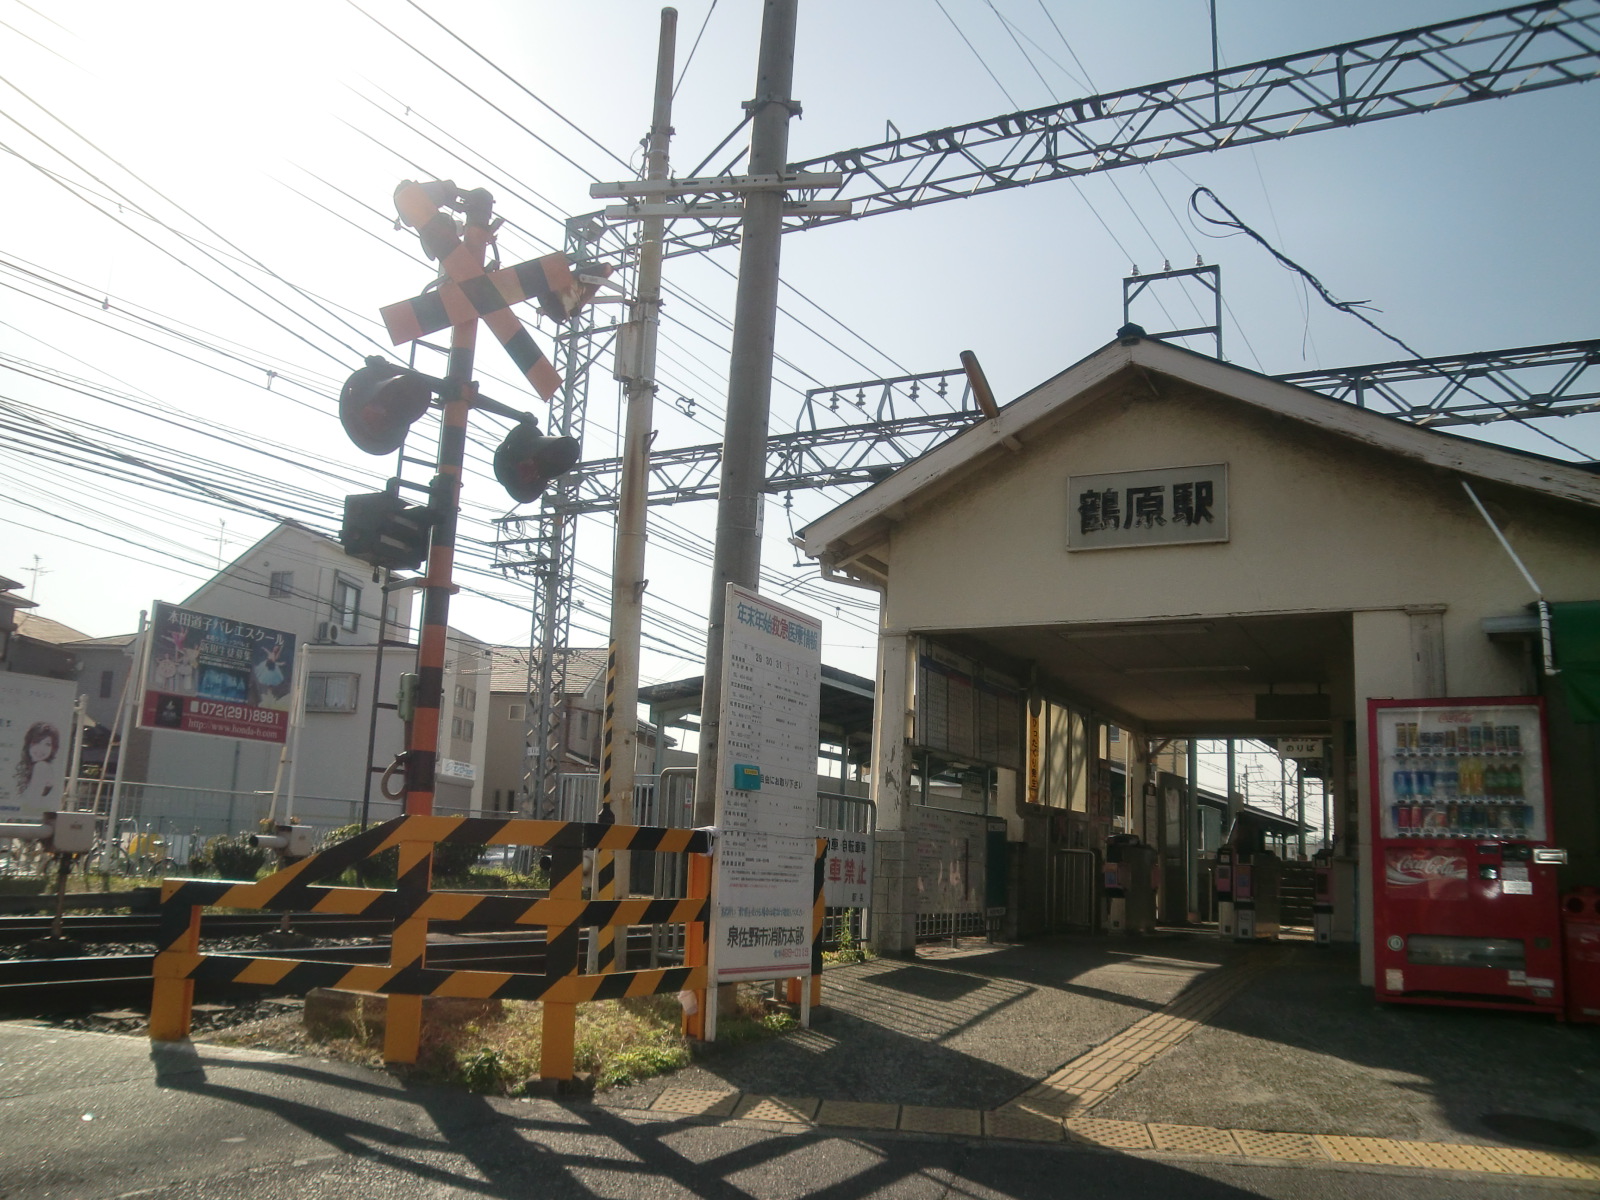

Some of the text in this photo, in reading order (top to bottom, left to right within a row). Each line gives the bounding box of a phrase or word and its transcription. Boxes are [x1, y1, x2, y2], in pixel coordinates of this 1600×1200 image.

[1078, 480, 1215, 535] 鶴原駅
[167, 610, 286, 646] 本田道子バレエスクール
[737, 602, 818, 651] 年末年始救急医療情報
[200, 702, 280, 725] 072(291)8981
[727, 925, 805, 948] 泉佐野市消防本部
